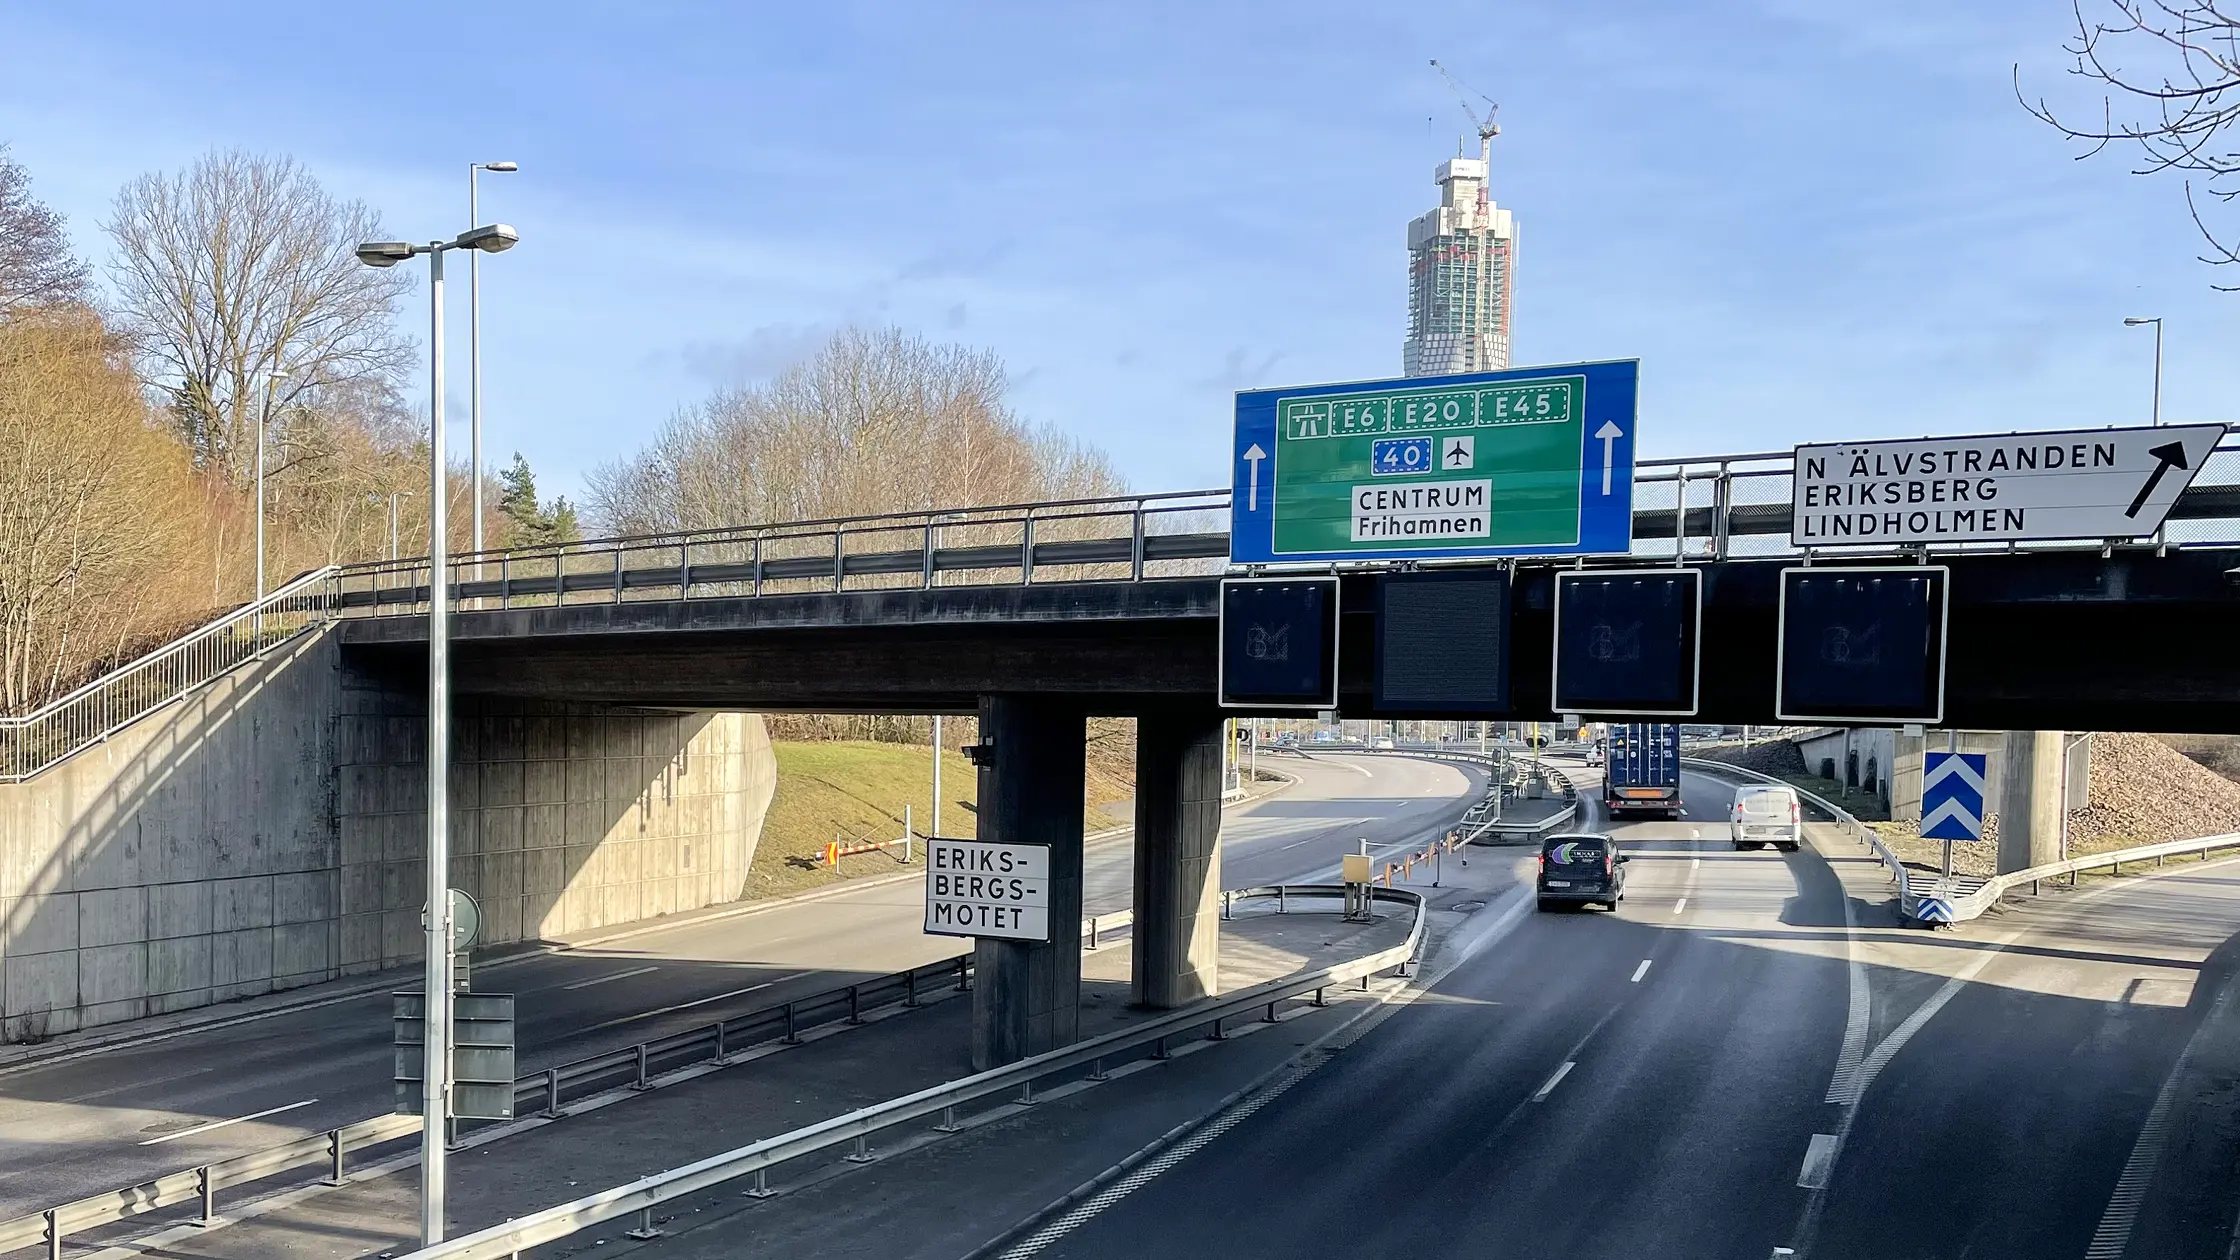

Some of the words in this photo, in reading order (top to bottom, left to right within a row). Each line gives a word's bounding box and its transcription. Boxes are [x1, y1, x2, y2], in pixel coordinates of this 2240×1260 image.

[1344, 407, 1375, 428] E6
[1405, 401, 1460, 423] E20
[1496, 394, 1551, 418] E45
[1383, 445, 1420, 466] 40
[1807, 457, 1825, 479] N
[1850, 443, 2115, 477] ÄLVSTRANDEN
[1360, 486, 1482, 510] CENTRUM
[1806, 477, 1998, 507] ERIKSBERG
[1360, 516, 1482, 536] Frihamnen
[1805, 508, 2025, 537] LINDHOLMEN
[936, 847, 1028, 872] ERIKS-
[935, 875, 1037, 900] BERGS-
[934, 903, 1023, 929] MOTET
